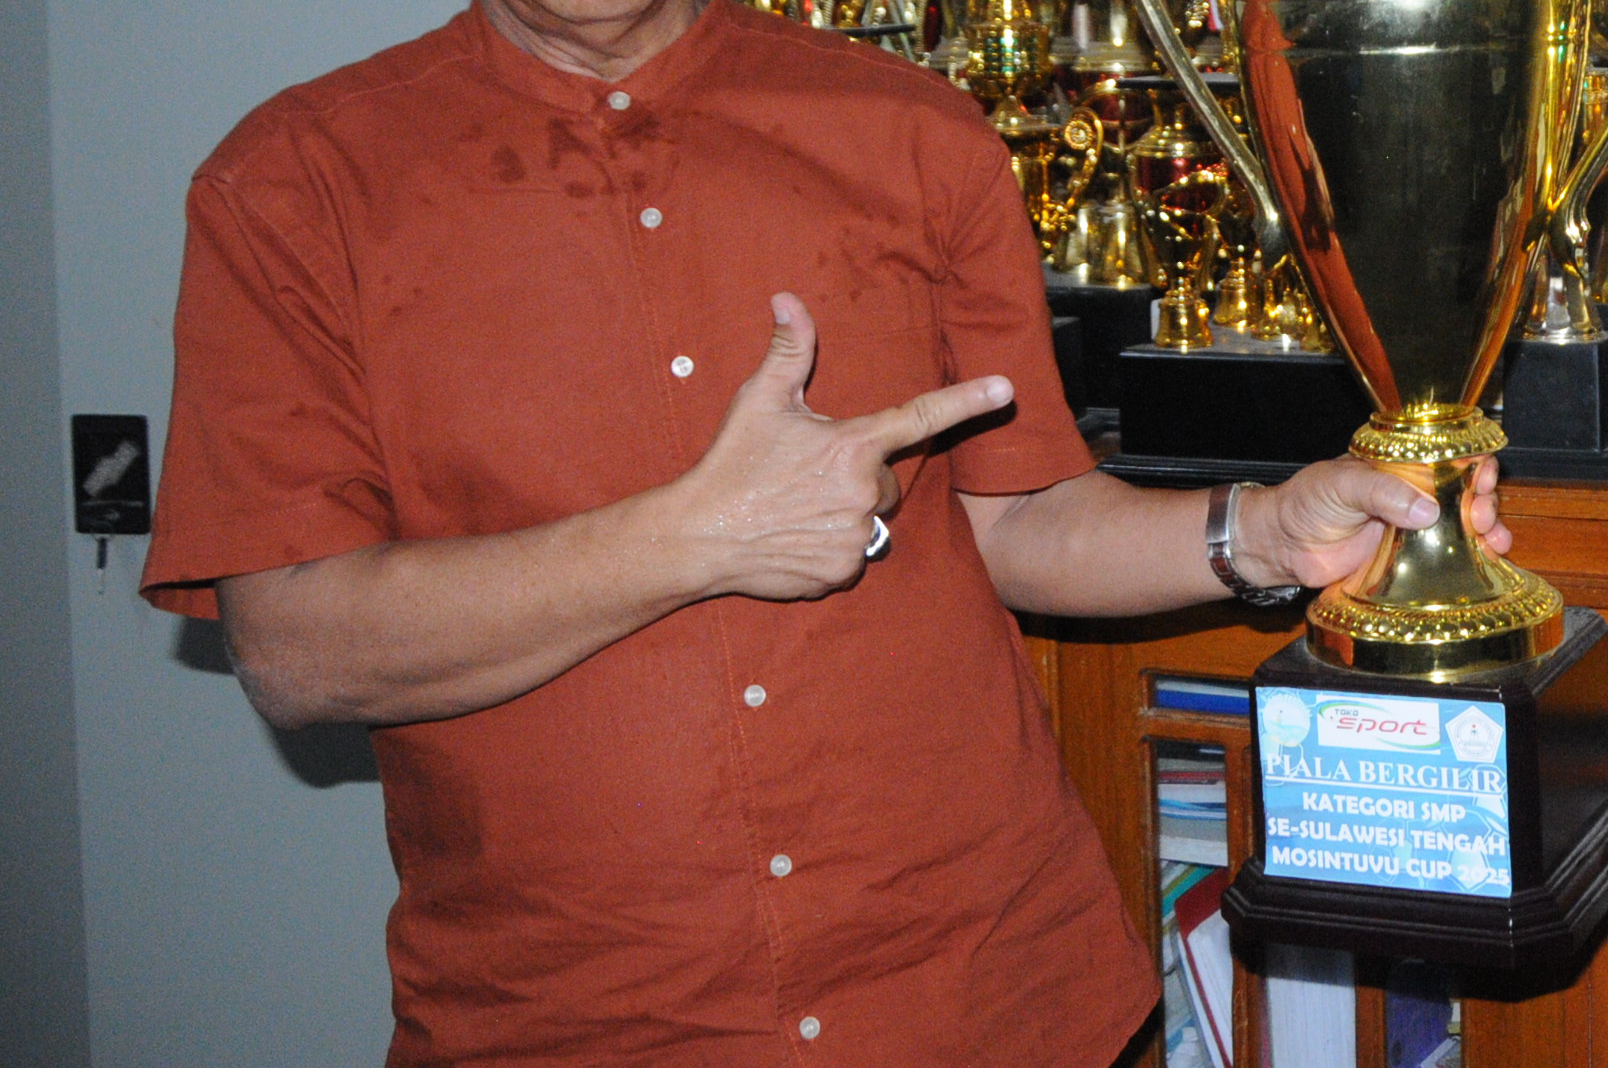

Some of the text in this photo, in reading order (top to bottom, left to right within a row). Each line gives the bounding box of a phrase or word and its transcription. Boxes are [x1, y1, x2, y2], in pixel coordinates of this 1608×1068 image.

[1334, 708, 1359, 717] TOKO
[1266, 753, 1502, 792] PIALA BERGILIR
[1302, 792, 1466, 823] KATEGORI SMP
[1267, 817, 1506, 856] SE-SULAWESI TENGAH
[1272, 846, 1511, 885] MOSINTUVU CUP 2025
